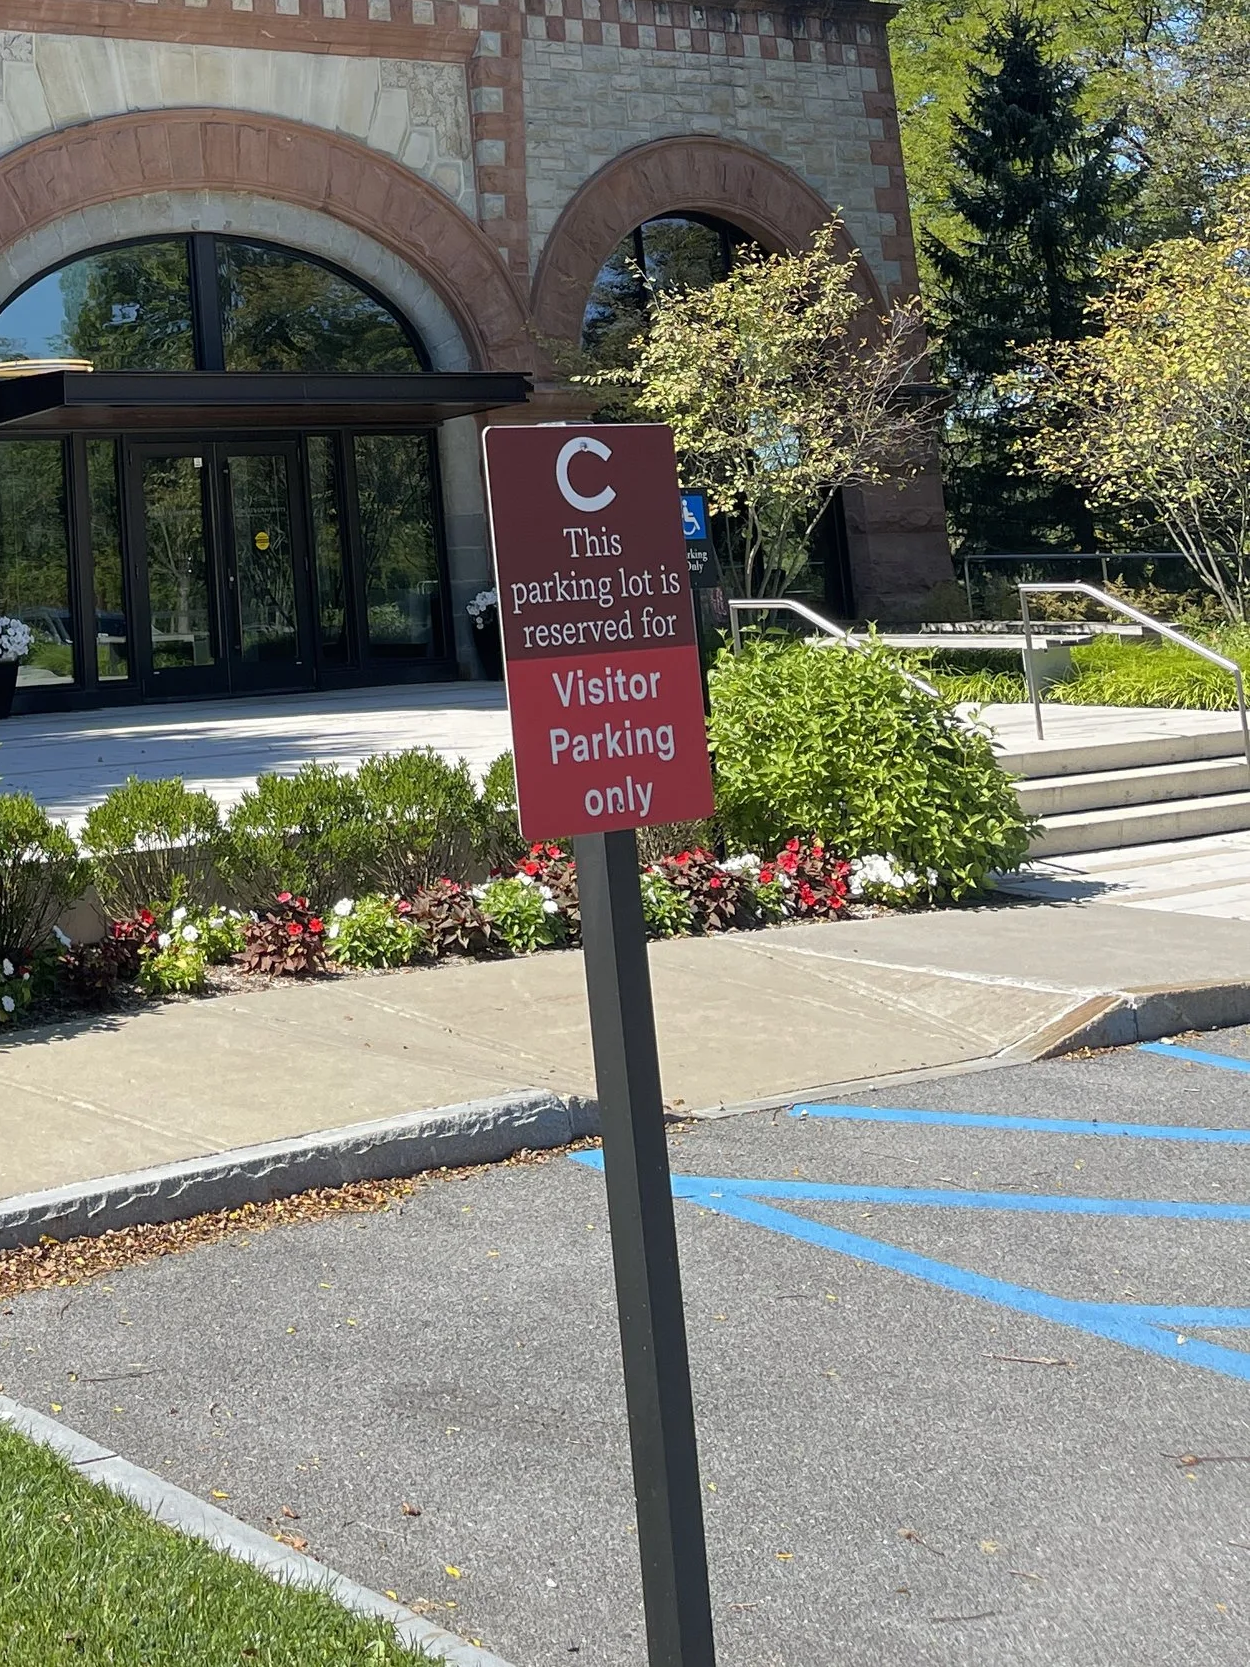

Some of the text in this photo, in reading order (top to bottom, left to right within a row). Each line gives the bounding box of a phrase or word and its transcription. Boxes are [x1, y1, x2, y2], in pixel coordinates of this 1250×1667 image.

[555, 436, 618, 513] C
[563, 526, 622, 558] This
[687, 548, 708, 562] rking
[511, 565, 681, 615] parking lot is
[523, 606, 677, 649] reserved for
[552, 665, 661, 708] Visitor
[549, 720, 675, 765] Parking
[584, 775, 654, 818] only
